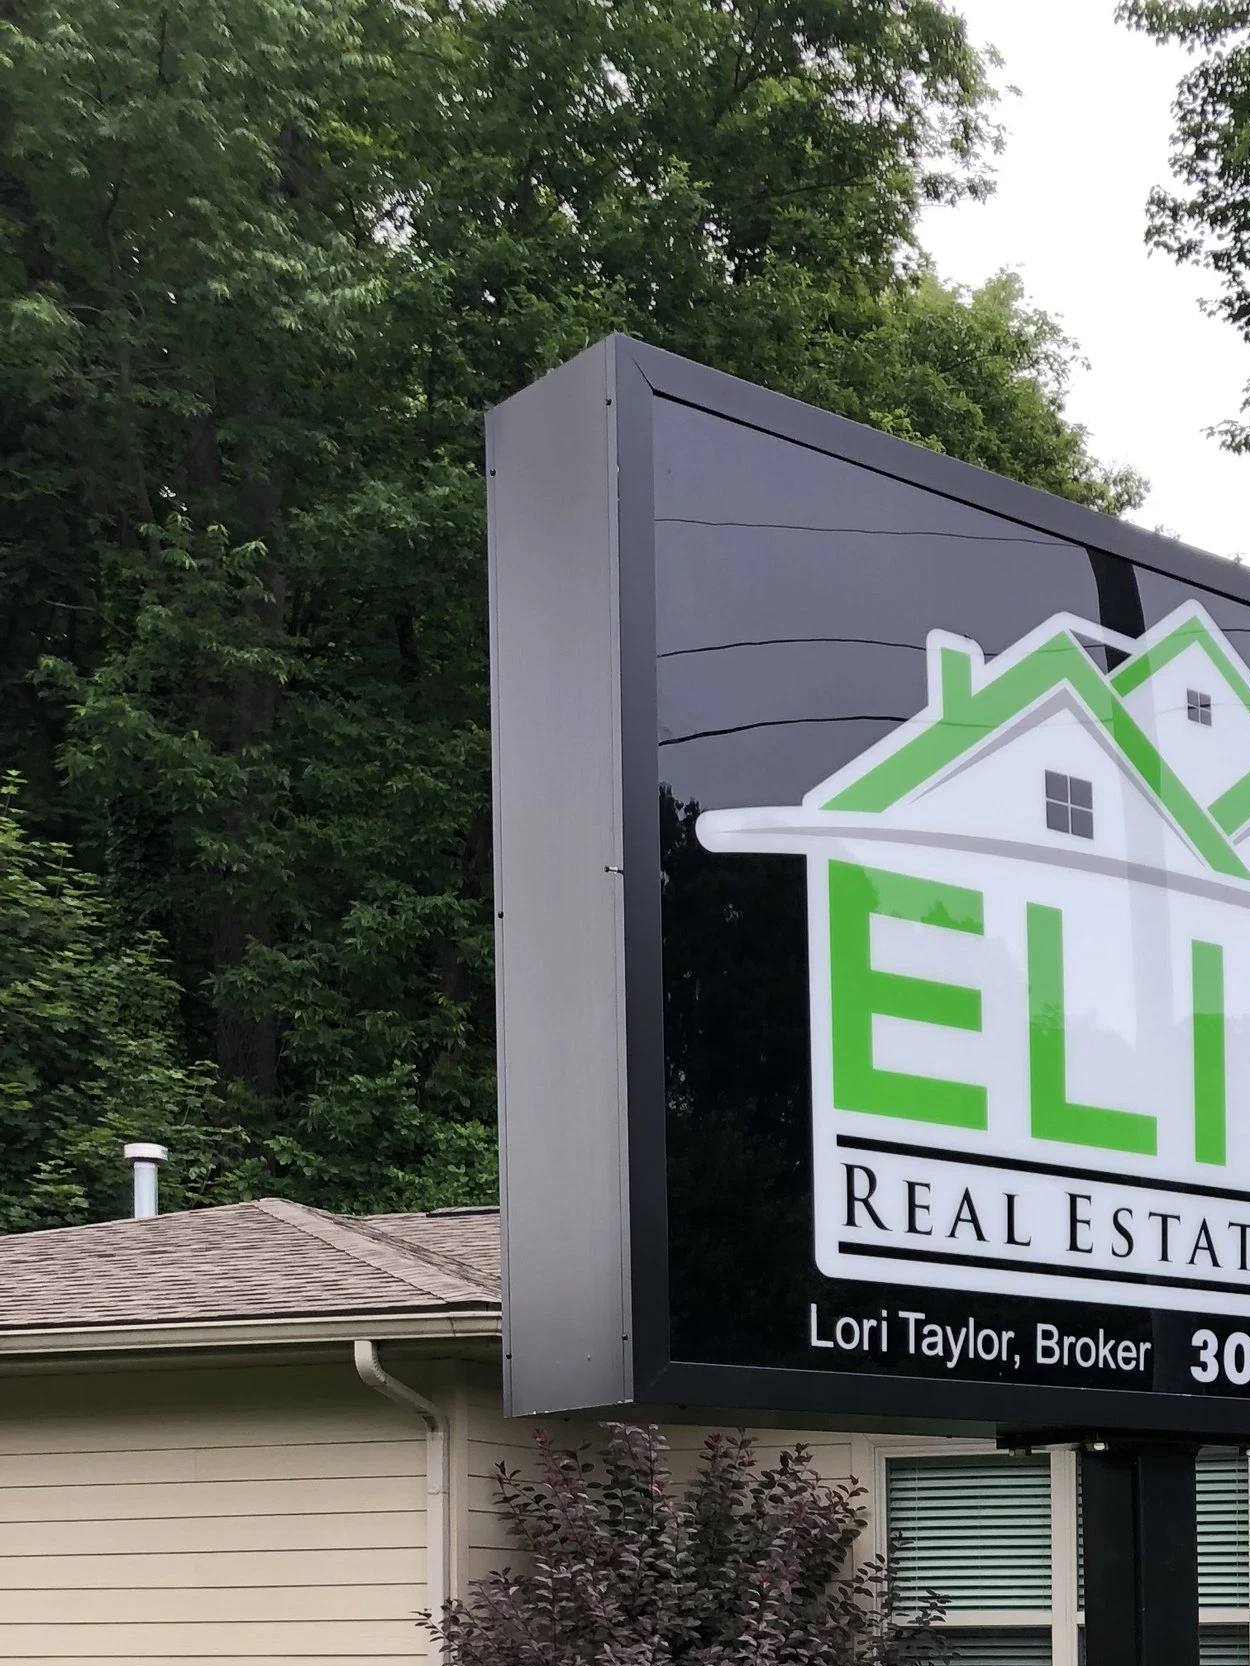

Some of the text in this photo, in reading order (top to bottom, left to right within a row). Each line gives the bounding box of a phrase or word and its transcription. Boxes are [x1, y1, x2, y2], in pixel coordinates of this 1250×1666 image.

[841, 1162, 1031, 1247] REAL
[809, 1304, 1152, 1372] Lori Taylor, Broker
